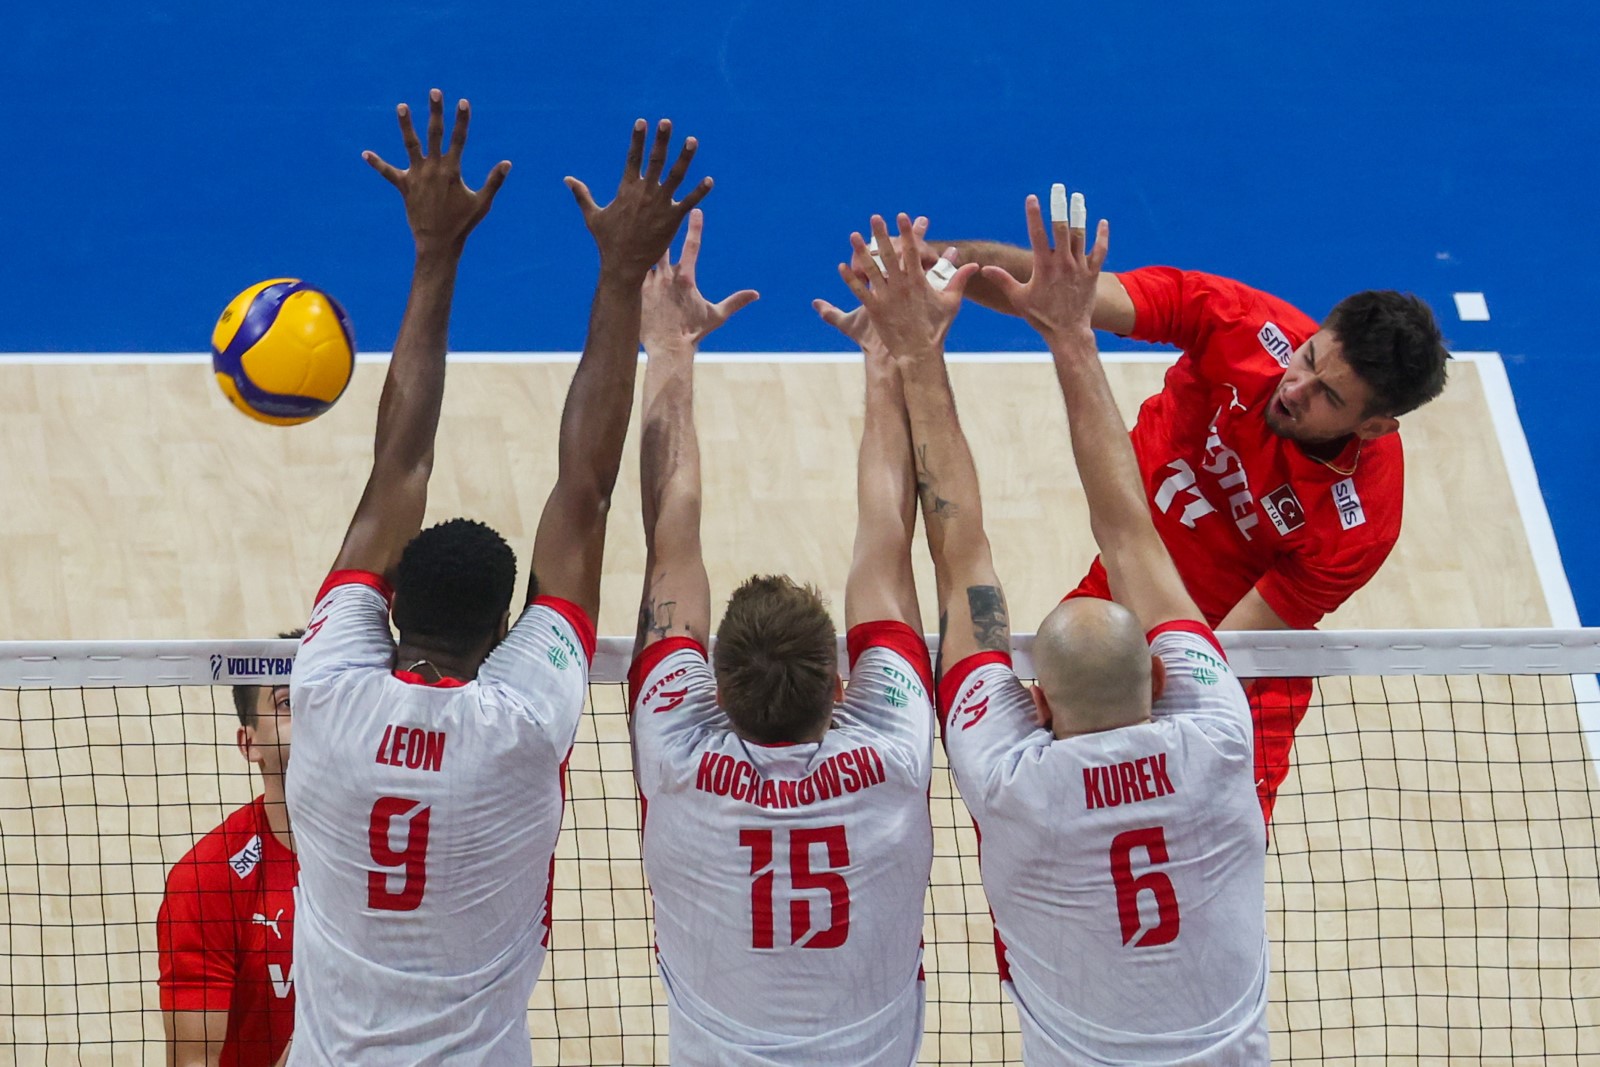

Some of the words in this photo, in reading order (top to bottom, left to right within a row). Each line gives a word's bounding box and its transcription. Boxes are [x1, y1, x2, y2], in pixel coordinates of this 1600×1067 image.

[1202, 405, 1259, 542] STEL
[1267, 504, 1284, 527] TUR
[1336, 483, 1359, 525] sms
[227, 657, 296, 676] VOLLEYBA
[882, 666, 923, 698] plus
[1184, 648, 1228, 673] plus
[641, 668, 688, 705] ORLEN
[950, 679, 985, 728] ORLEN
[375, 723, 446, 772] LEON
[695, 745, 886, 810] KOCHANOWSKI
[1082, 752, 1176, 810] KUREK
[367, 796, 431, 912] 9
[739, 824, 852, 950] 15
[1109, 826, 1180, 949] 6
